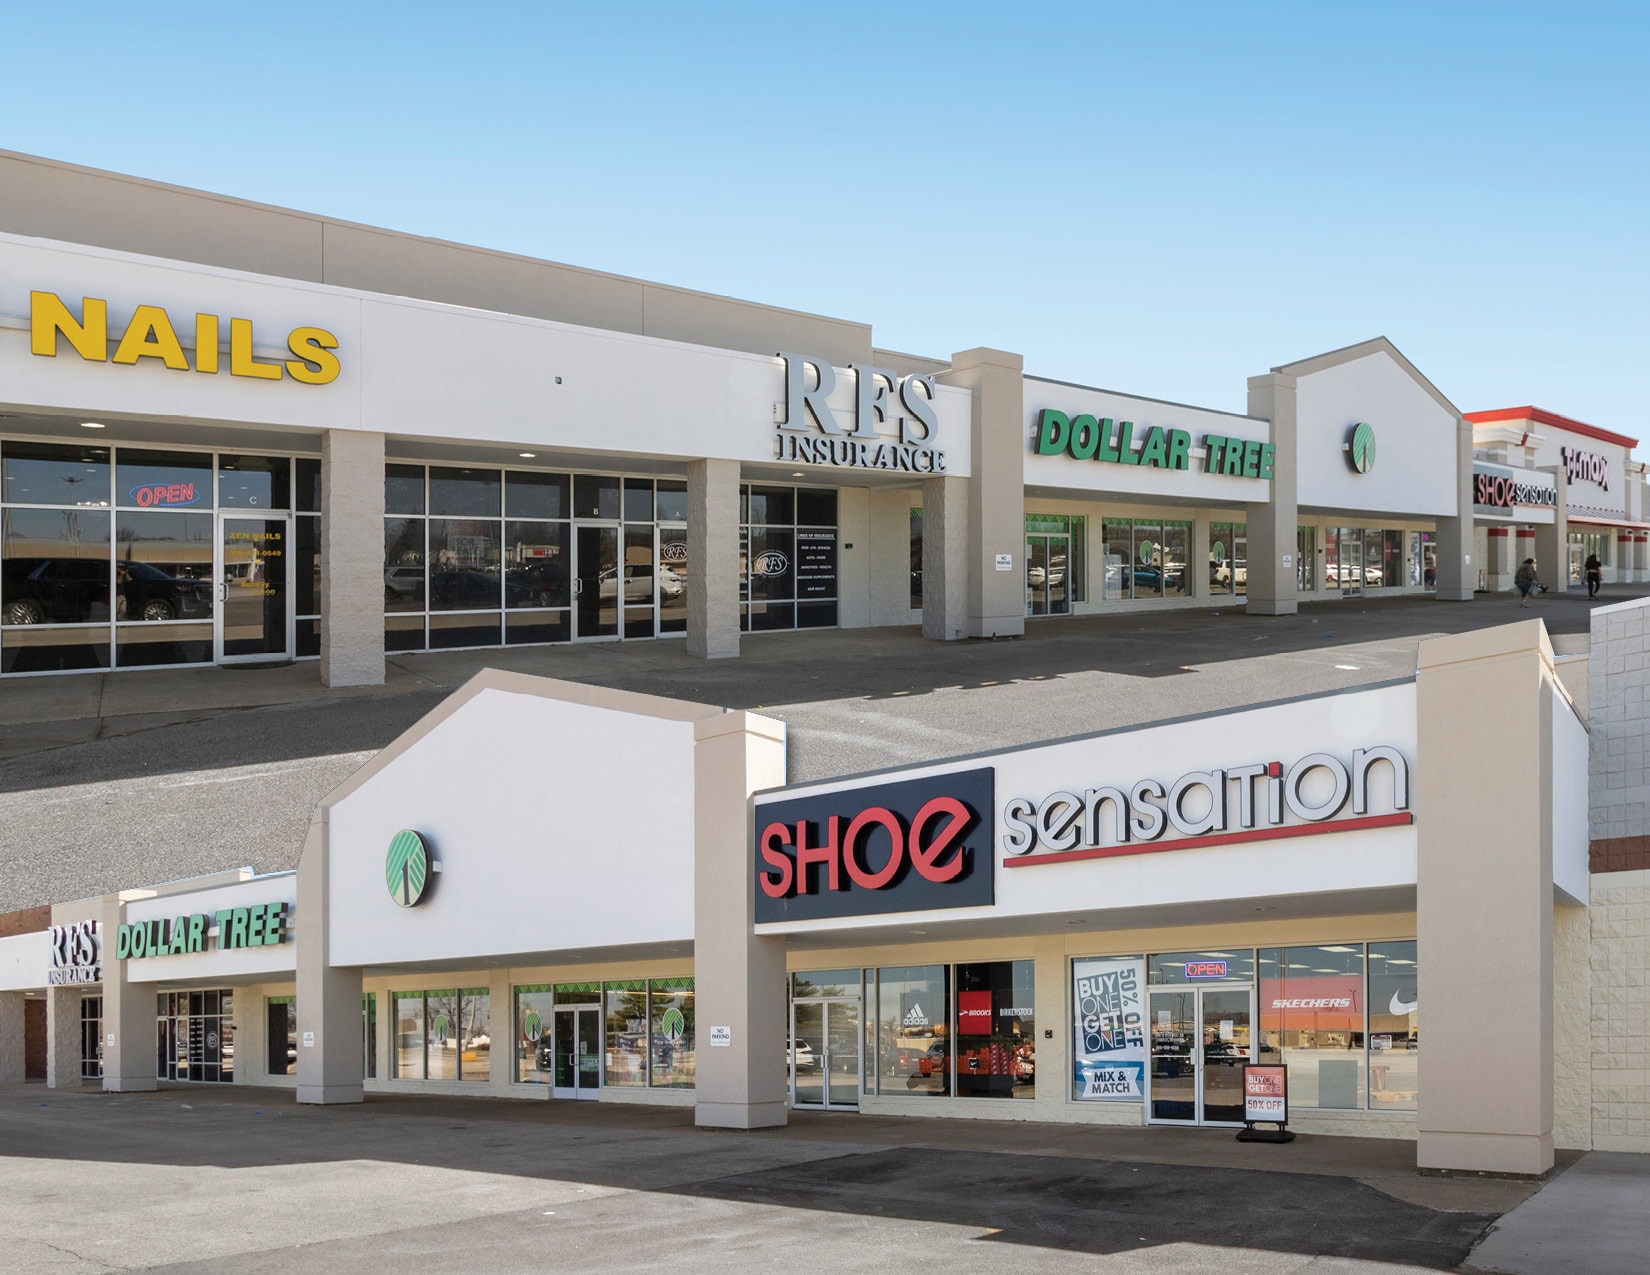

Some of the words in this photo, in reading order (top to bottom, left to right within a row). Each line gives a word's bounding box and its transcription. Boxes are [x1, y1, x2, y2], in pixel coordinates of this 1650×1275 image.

[30, 290, 341, 385] NAILS
[776, 351, 939, 446] RFS
[1034, 408, 1191, 471] DOLLAR
[1202, 434, 1276, 480] TREE
[776, 434, 947, 473] INSURANCE
[136, 483, 194, 507] OPEN
[249, 496, 257, 504] C
[229, 532, 250, 540] ZEN
[252, 532, 281, 540] NAILS
[456, 537, 475, 546] FOR
[666, 546, 687, 559] RFS
[761, 556, 784, 572] RFS
[115, 913, 208, 960] DOLLAR
[215, 902, 288, 950] TREE
[48, 919, 98, 968] RFS
[48, 966, 97, 985] INSURANCE
[1186, 963, 1226, 976] OPEN
[1079, 974, 1116, 999] BUY
[1119, 967, 1139, 1007] 50%
[1081, 992, 1121, 1015] ONE
[1271, 998, 1351, 1009] SKECHERS
[968, 1009, 992, 1017] BROOKS
[1000, 1007, 1034, 1017] BIRKENSTOCK
[903, 1017, 929, 1025] adidas
[1083, 1011, 1121, 1033] GET
[1124, 1011, 1144, 1048] OFF
[1086, 1029, 1125, 1051] ONE
[1094, 1071, 1115, 1083] MIX
[1117, 1070, 1127, 1082] &
[1249, 1075, 1264, 1084] BUY
[1264, 1075, 1280, 1084] ONE
[1091, 1082, 1131, 1094] MATCH
[1249, 1084, 1265, 1092] GET
[1247, 1100, 1264, 1110] 50%
[1266, 1100, 1282, 1110] OFF
